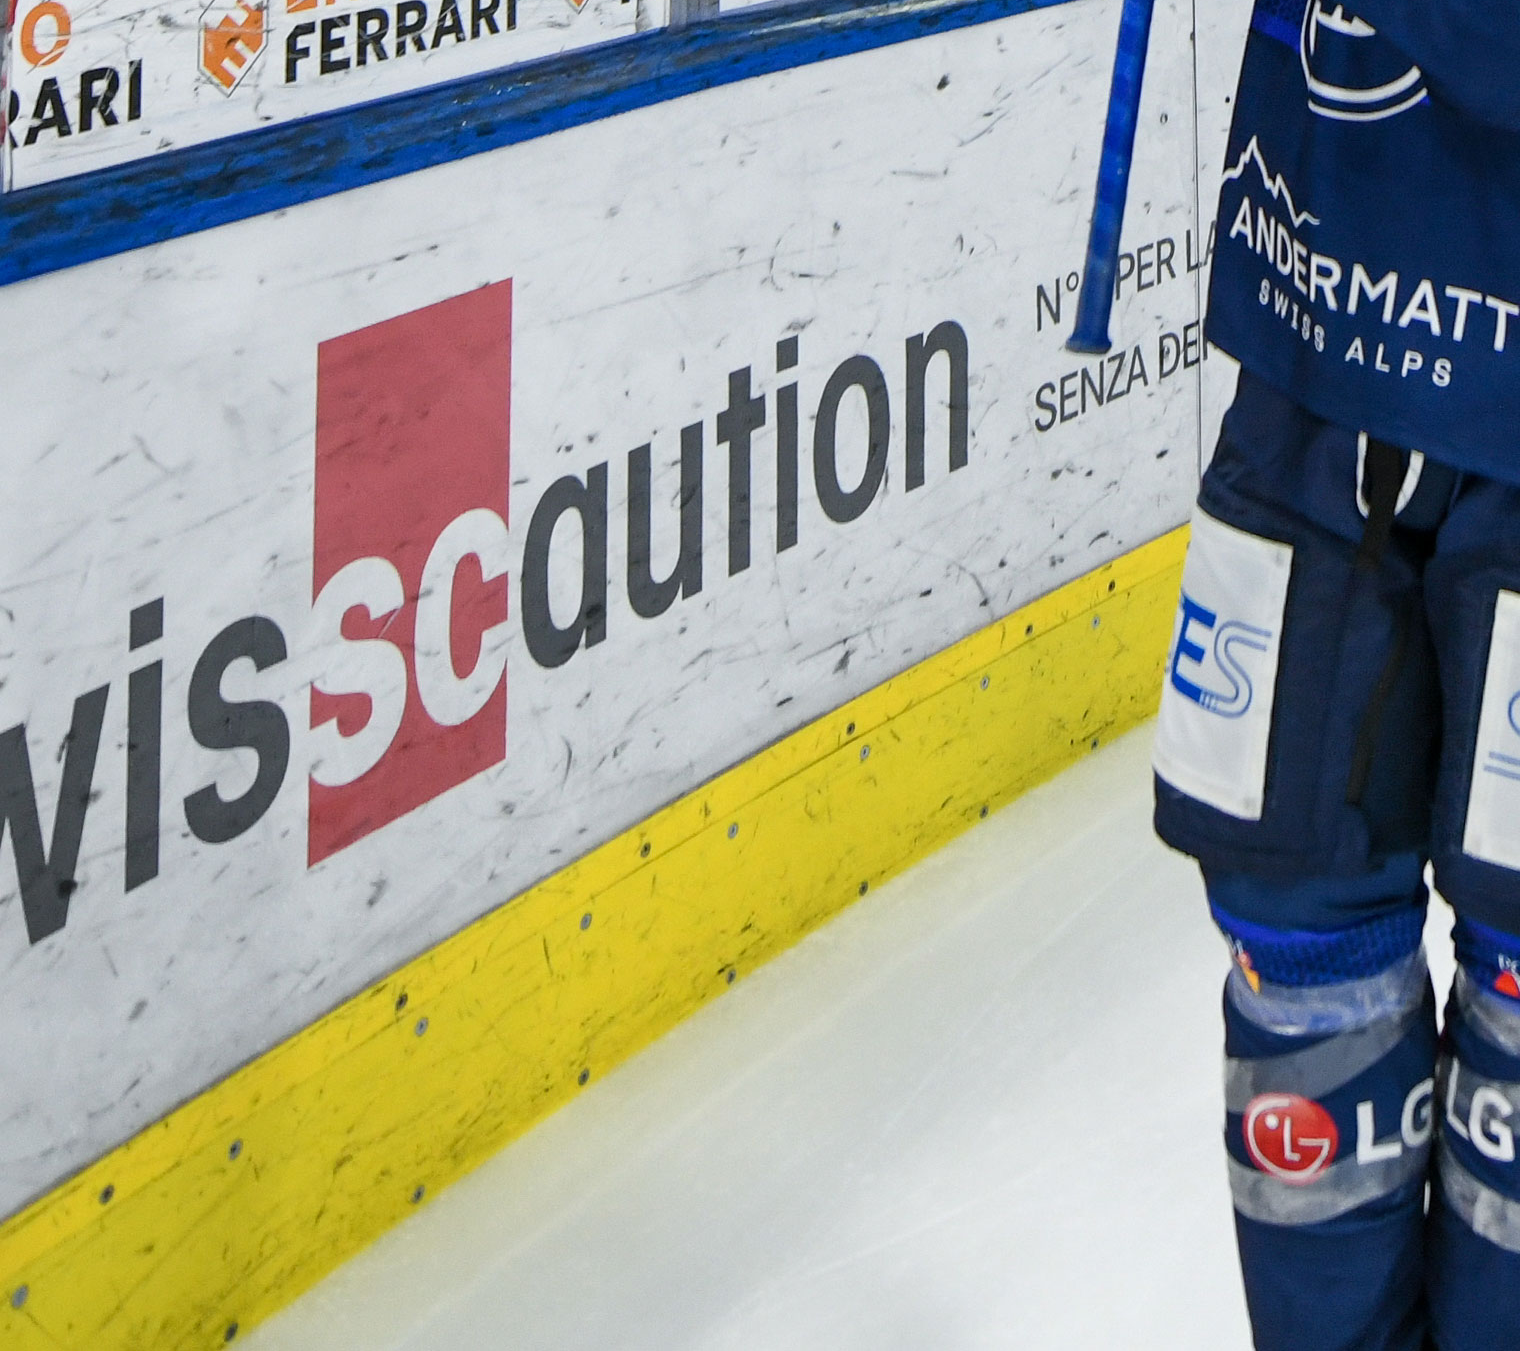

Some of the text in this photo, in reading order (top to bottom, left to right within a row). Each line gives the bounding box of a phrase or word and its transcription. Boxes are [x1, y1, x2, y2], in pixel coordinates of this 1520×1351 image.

[1228, 194, 1520, 353] ANDERMATT
[1033, 342, 1149, 434] SENZA
[1256, 283, 1455, 388] SWISS ALPS
[1166, 595, 1273, 719] ES
[1357, 1088, 1436, 1164] LG
[1446, 1055, 1515, 1164] LG
